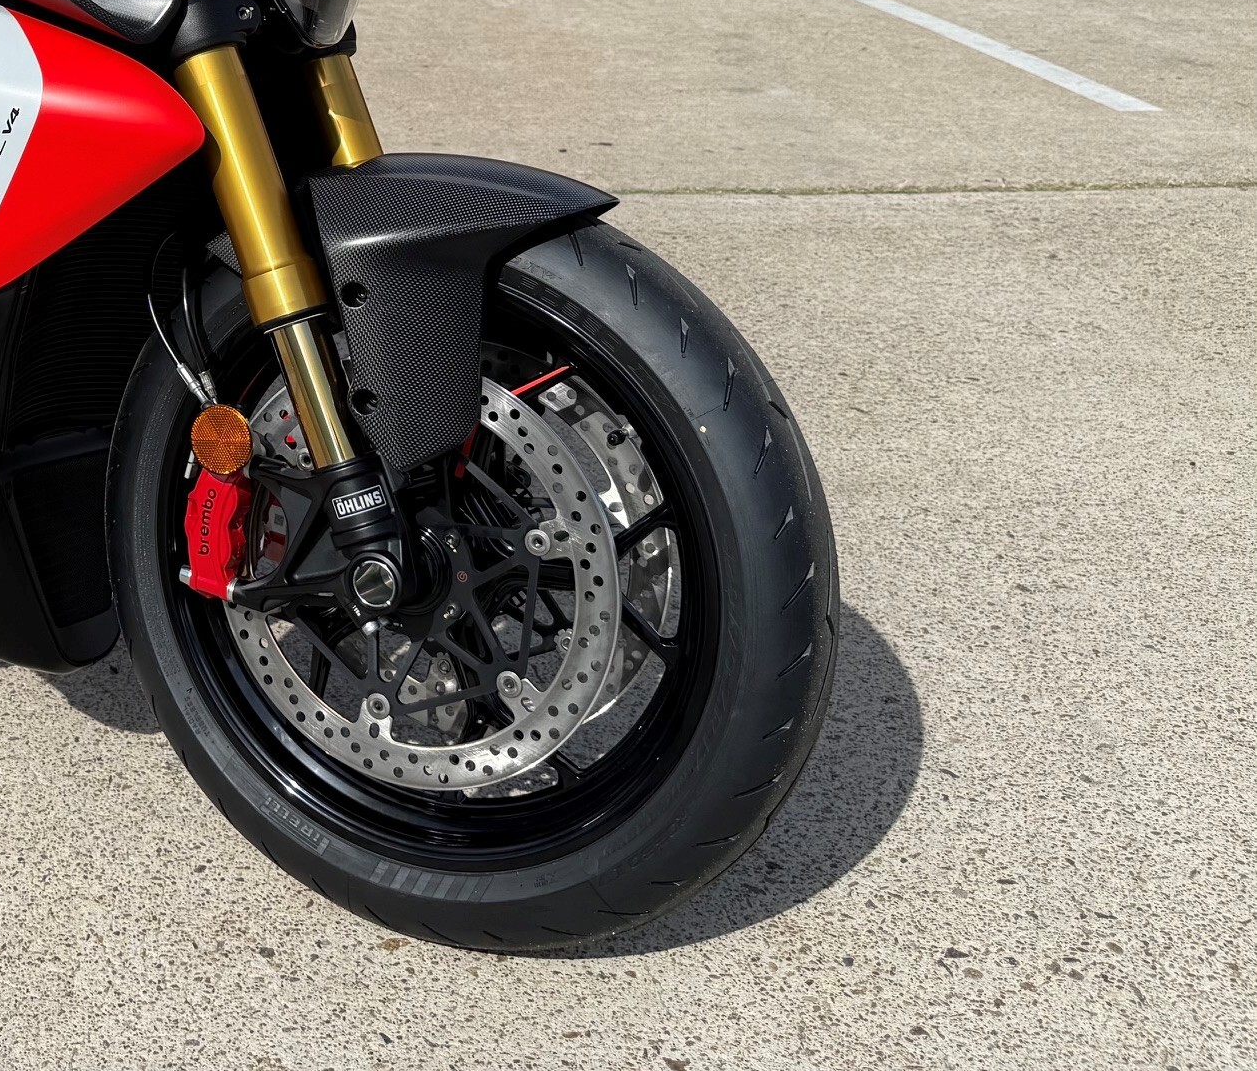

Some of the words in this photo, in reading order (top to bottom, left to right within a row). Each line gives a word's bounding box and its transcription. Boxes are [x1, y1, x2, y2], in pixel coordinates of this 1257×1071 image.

[1, 107, 21, 135] V4
[198, 487, 218, 556] brembo
[335, 489, 383, 517] ÖHLINS
[260, 796, 331, 857] PIRELLI
